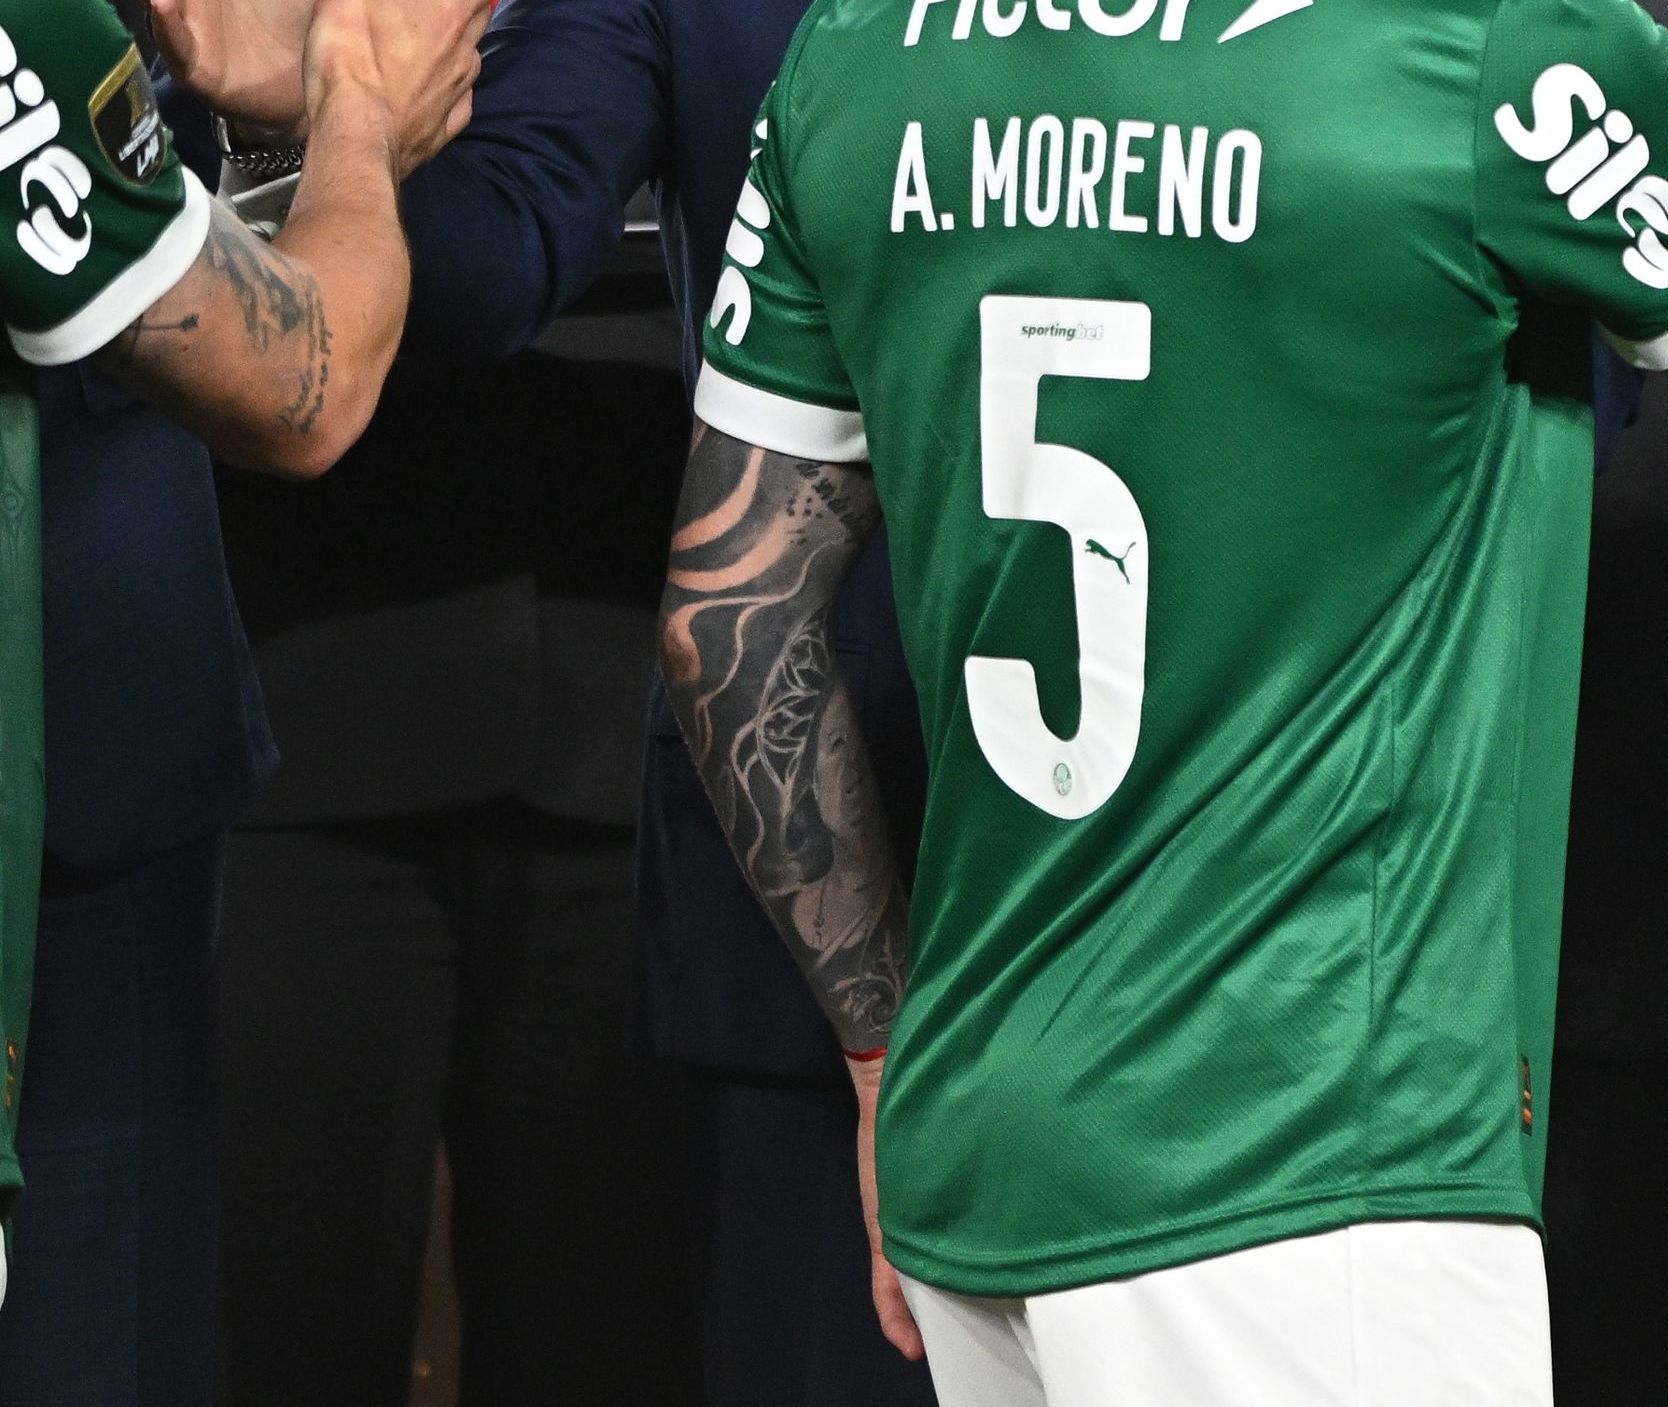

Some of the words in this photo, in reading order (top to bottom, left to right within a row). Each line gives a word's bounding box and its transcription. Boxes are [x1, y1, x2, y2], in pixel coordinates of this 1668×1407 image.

[890, 121, 955, 233] A.
[971, 114, 1263, 243] MORENO
[1021, 323, 1105, 342] sportingbet
[964, 295, 1152, 820] 5
